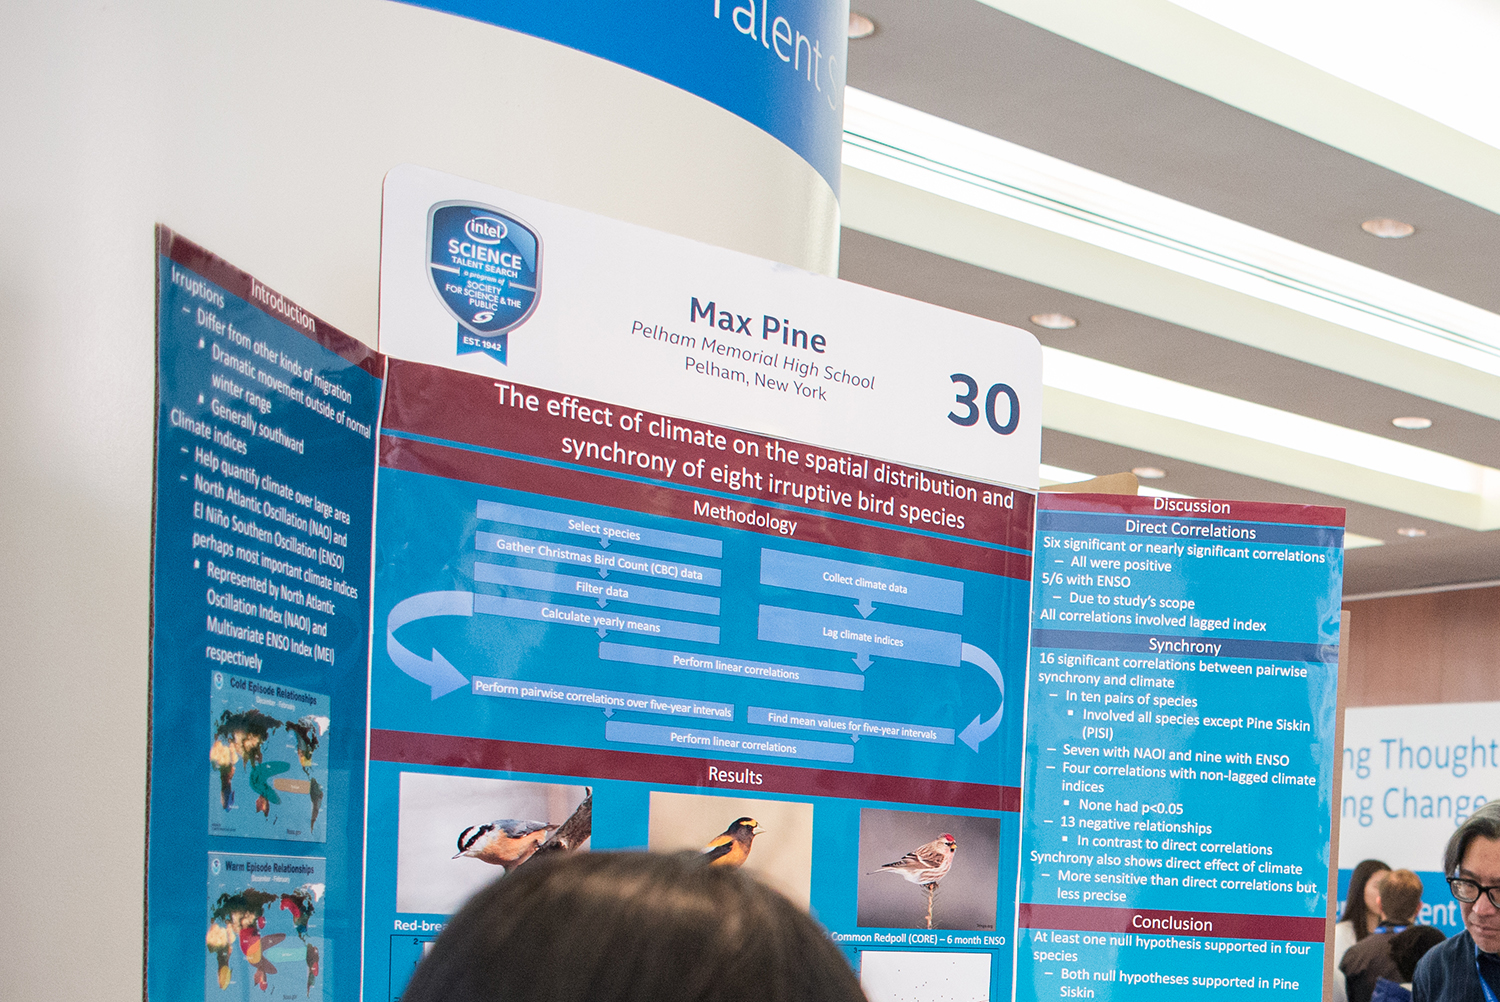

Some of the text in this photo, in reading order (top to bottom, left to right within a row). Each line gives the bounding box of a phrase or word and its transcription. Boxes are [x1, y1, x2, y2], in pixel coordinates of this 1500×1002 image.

[471, 219, 501, 238] intel
[448, 238, 522, 271] SCIENCE
[451, 256, 518, 278] TALENT SEARCH
[469, 271, 497, 284] program
[172, 265, 223, 308] Irruptions
[445, 283, 522, 309] FOR SCIENCE & THE
[467, 280, 501, 295] SOCIETY
[252, 278, 314, 331] Introduction
[469, 298, 498, 311] PUBLIC
[690, 297, 825, 352] Max Pine
[463, 336, 502, 351] EST. 1942
[632, 320, 874, 389] Pelham Memorial High School
[197, 310, 350, 403] Differ from other kinds of migration
[685, 356, 826, 400] Pelham, New York
[947, 375, 1019, 434] 30
[170, 409, 246, 454] Climate indices
[494, 383, 1014, 510] The effect of climate on the spatial distribution and
[561, 437, 964, 528] synchrony of eight irruptive bird species
[1153, 497, 1229, 513] Discussion
[568, 519, 640, 540] Select species
[694, 500, 797, 535] Methodology
[1126, 519, 1255, 539] Direct Correlations
[496, 539, 702, 579] Gather Christmas Bird Count (CBC) data
[1043, 536, 1324, 562] Six significant or nearly significant correlations
[576, 581, 628, 597] Filter data
[823, 572, 907, 593] Collect climate data
[1042, 572, 1130, 587] 5/6 with ENSO
[541, 607, 660, 632] Calculate yearly means
[823, 627, 903, 646] Lag climate indices
[1149, 637, 1221, 656] Synchrony
[673, 655, 799, 679] Perform linear correlations
[475, 680, 731, 717] Perform pairwise correlations over five-year intervals
[1380, 736, 1498, 777] Thought
[709, 766, 762, 784] Results
[1132, 915, 1212, 931] Conclusion
[830, 931, 871, 941] Common
[874, 933, 906, 944] Redpoll
[908, 933, 937, 945] (CORE)
[947, 935, 952, 943] 6
[954, 935, 981, 944] month
[983, 936, 1005, 945] ENSO
